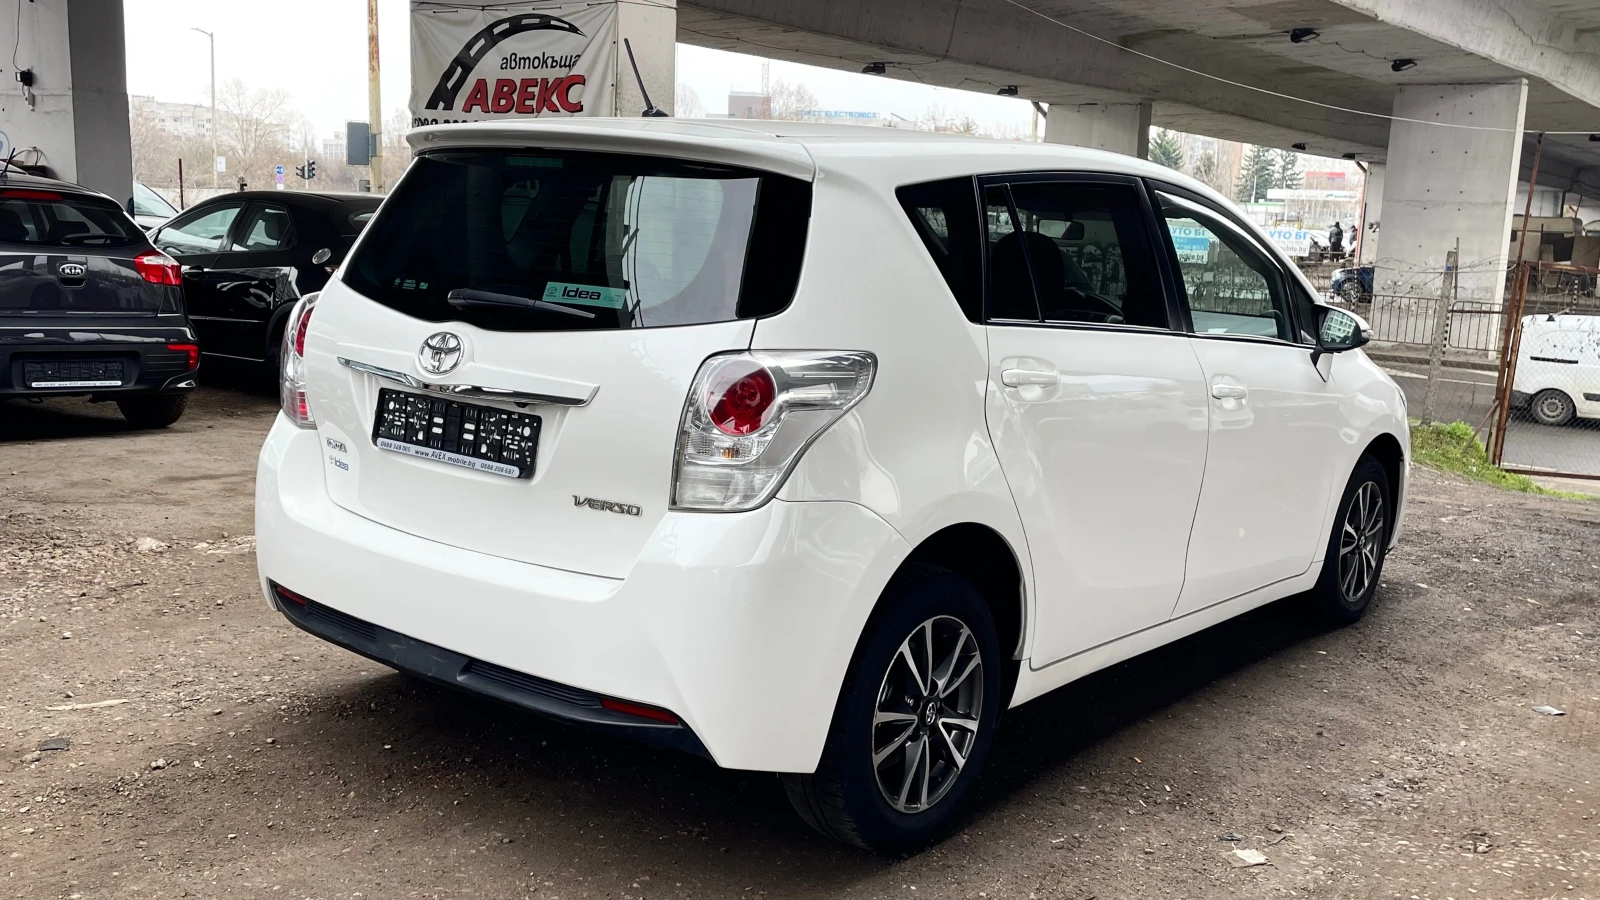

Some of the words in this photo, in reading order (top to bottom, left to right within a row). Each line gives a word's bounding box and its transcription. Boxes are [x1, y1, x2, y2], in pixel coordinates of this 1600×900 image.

[461, 74, 587, 114] АВЕКС
[825, 110, 877, 119] ELECTRONICS
[64, 266, 82, 275] KIA
[561, 285, 602, 301] Idea
[414, 448, 430, 457] www
[430, 451, 447, 461] AVEX
[571, 494, 642, 517] VERSO
